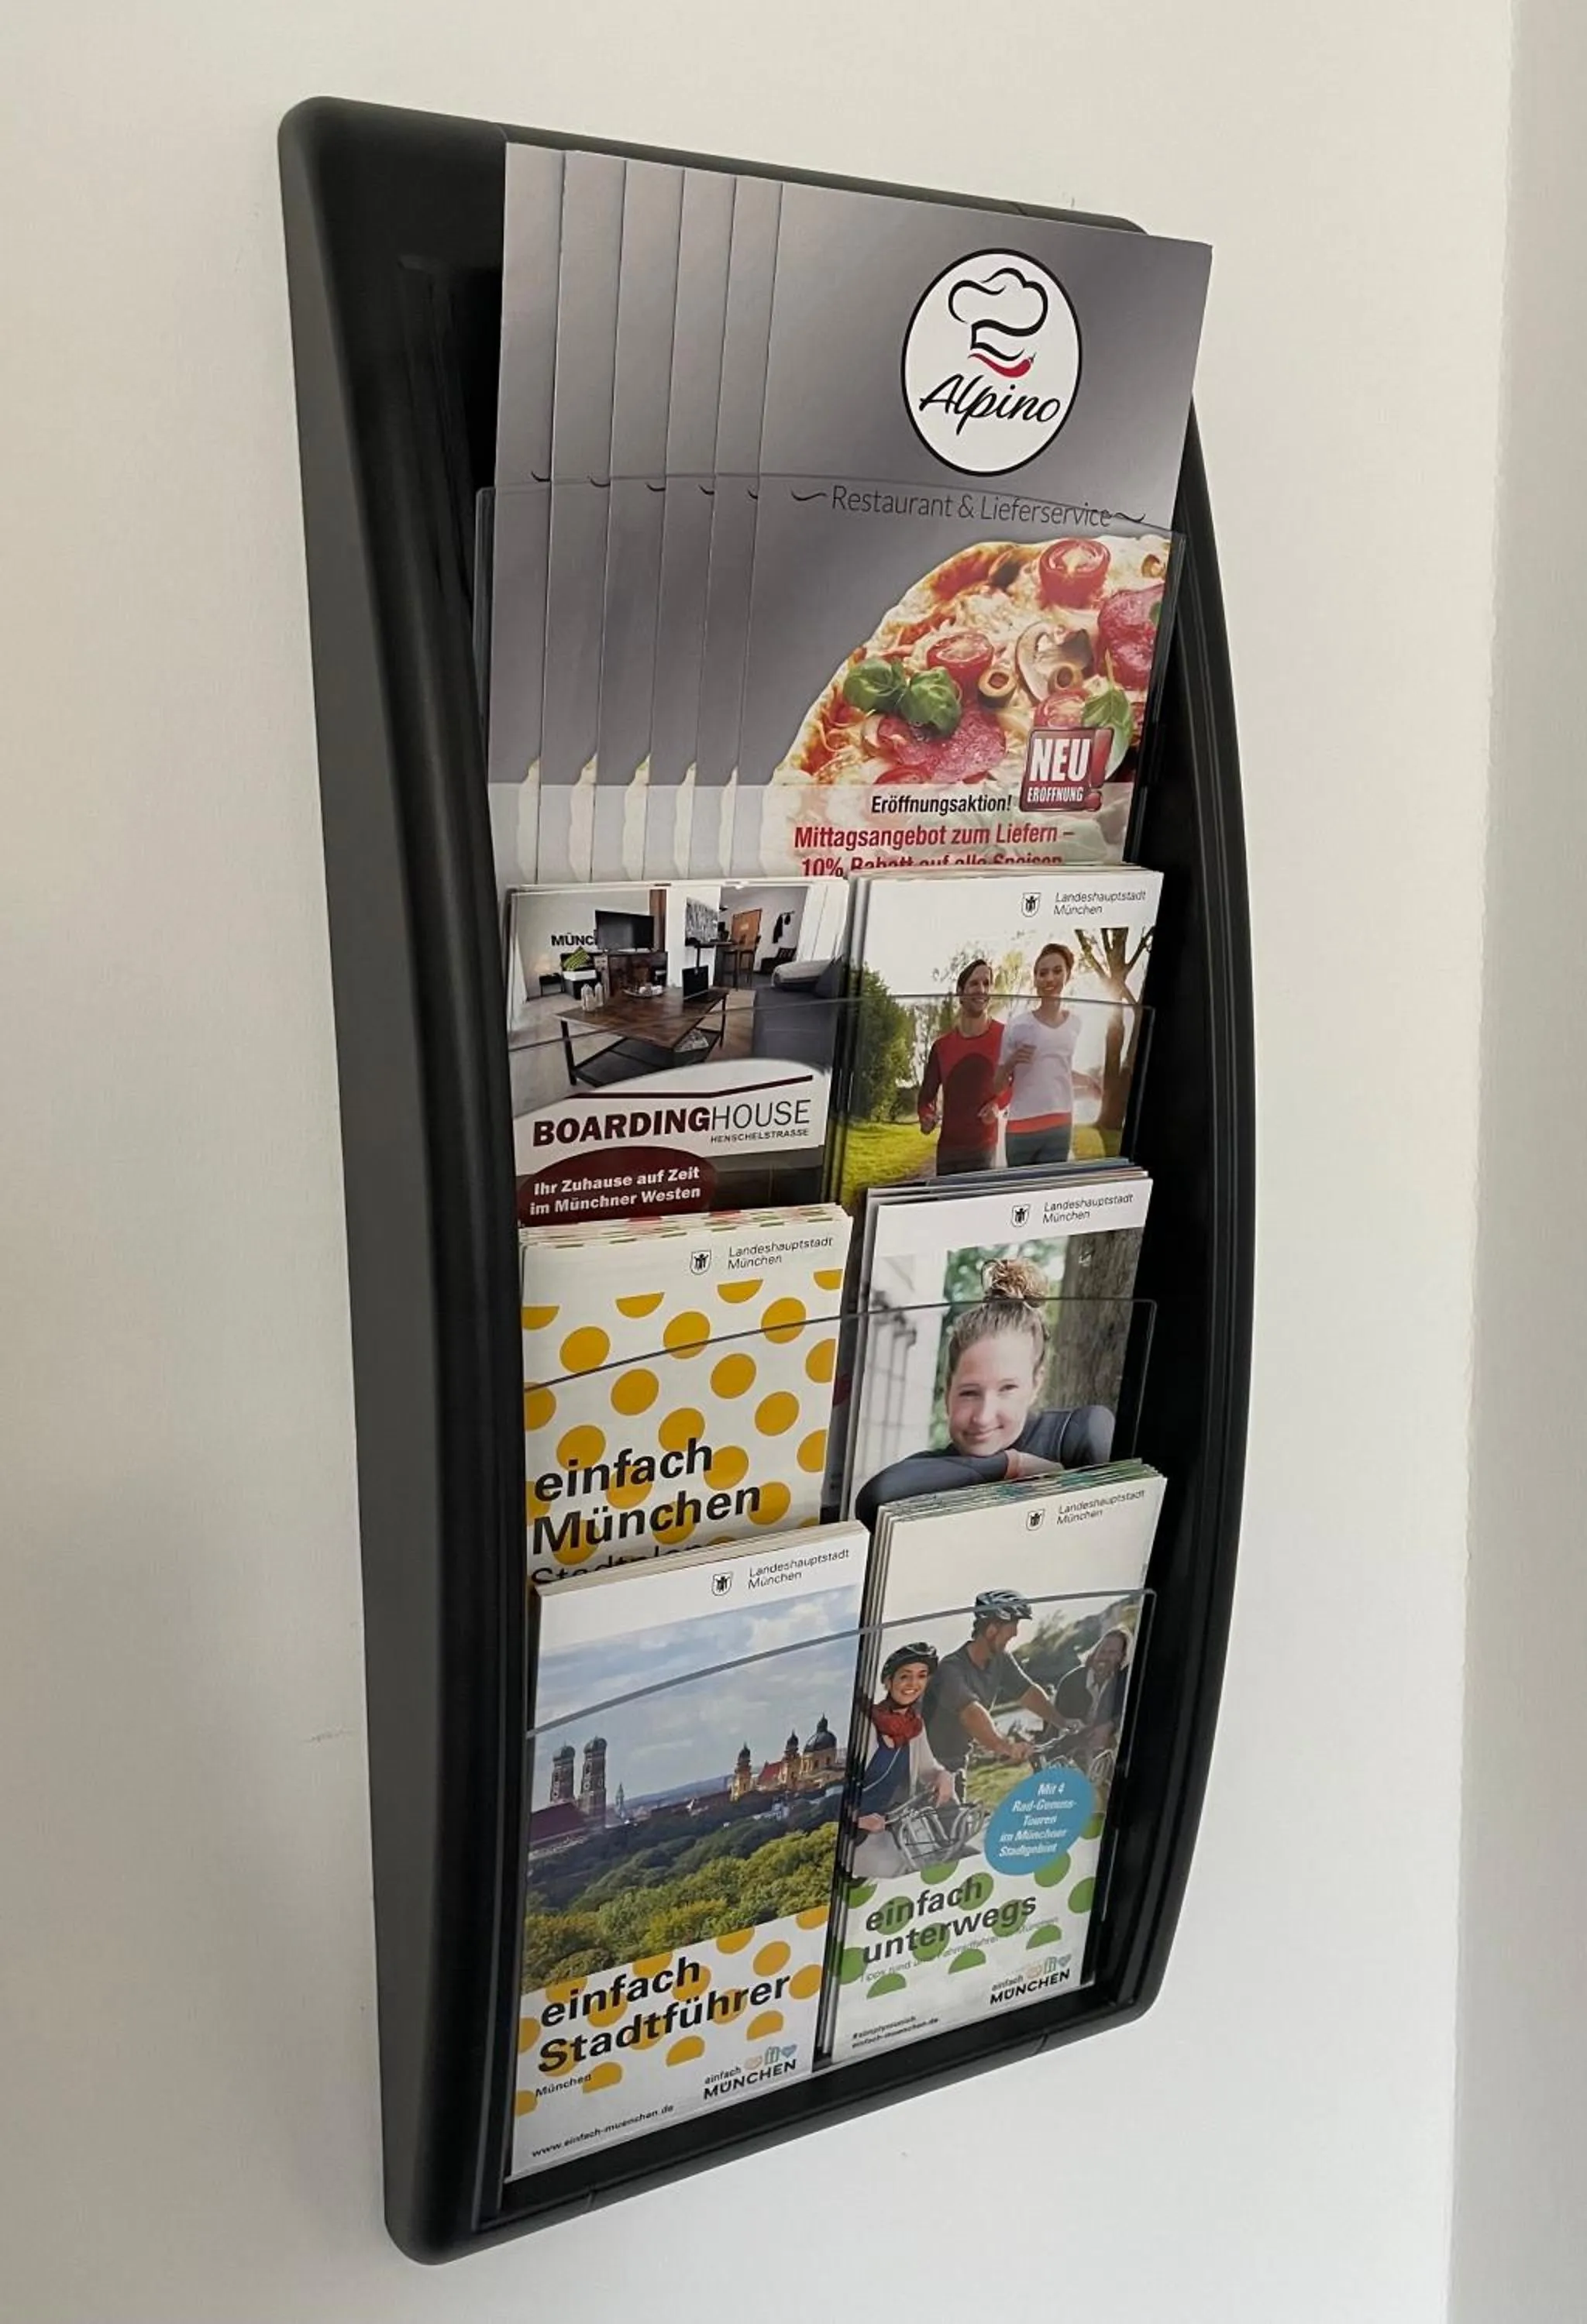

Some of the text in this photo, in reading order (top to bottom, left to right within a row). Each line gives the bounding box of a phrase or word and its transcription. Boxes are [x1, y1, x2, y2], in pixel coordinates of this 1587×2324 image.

[918, 373, 1062, 435] Alpino
[832, 485, 1114, 528] Restaurant & Lieferservice
[871, 794, 1012, 816] Eröffnungsaktion!
[794, 825, 946, 851] Mittagsangebot
[952, 827, 990, 844] zum
[996, 823, 1057, 843] Liefern
[801, 858, 844, 877] 10%
[1053, 904, 1103, 915] München
[1055, 890, 1146, 903] Landeshauptstadt
[533, 1099, 811, 1147] BOARDINGHOUSE
[711, 1128, 810, 1143] HENSCHELSTRASSE
[534, 1166, 701, 1195] Ihr Zuhause auf Zeit
[530, 1186, 701, 1215] im Münchner Westen
[1044, 1194, 1134, 1212] Landeshauptstadt
[1042, 1210, 1090, 1224] München
[729, 1237, 834, 1257] Landeshauptstadt
[728, 1254, 782, 1270] München
[534, 1438, 712, 1502] einfach
[1059, 1490, 1145, 1514] Landeshauptstadt
[531, 1485, 761, 1556] München
[1056, 1509, 1103, 1525] München
[749, 1549, 850, 1578] Landeshauptstadt
[748, 1571, 802, 1590] München
[865, 1874, 983, 1931] einfach
[862, 1896, 1037, 1965] unterwegs
[541, 1956, 701, 2028] einfach
[990, 1968, 1070, 2005] MÜNCHEN
[538, 1974, 790, 2073] Stadtführer
[535, 2073, 592, 2099] München
[703, 2059, 797, 2100] MÜNCHEN
[704, 2066, 742, 2084] einfach
[532, 2104, 674, 2157] www.einfach-muenchen.de
